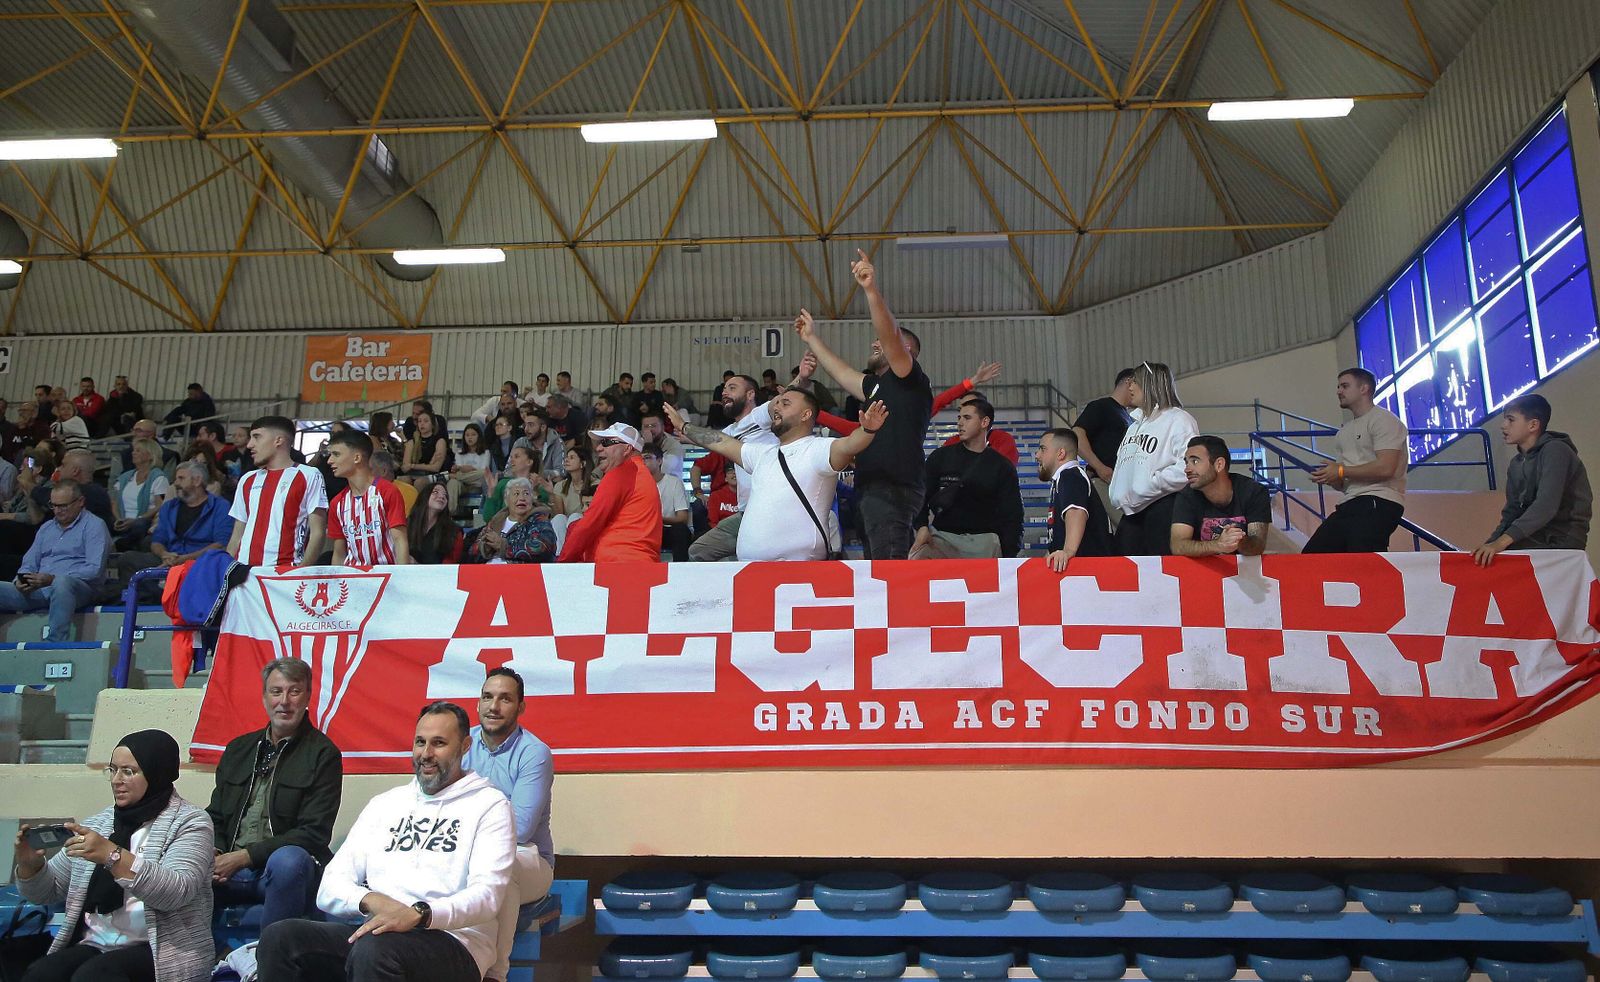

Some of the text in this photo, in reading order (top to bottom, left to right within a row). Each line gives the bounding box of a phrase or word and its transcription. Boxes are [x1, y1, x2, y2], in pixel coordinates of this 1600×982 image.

[345, 336, 391, 357] Bar
[766, 328, 781, 357] D
[309, 358, 423, 382] Cafetería
[286, 620, 353, 630] ALGECIRAS C.F.
[426, 552, 1600, 699] ALGECIRA
[62, 666, 68, 676] 2
[753, 699, 1383, 736] GRADA ACF FONDO SUR
[384, 831, 458, 853] JONES
